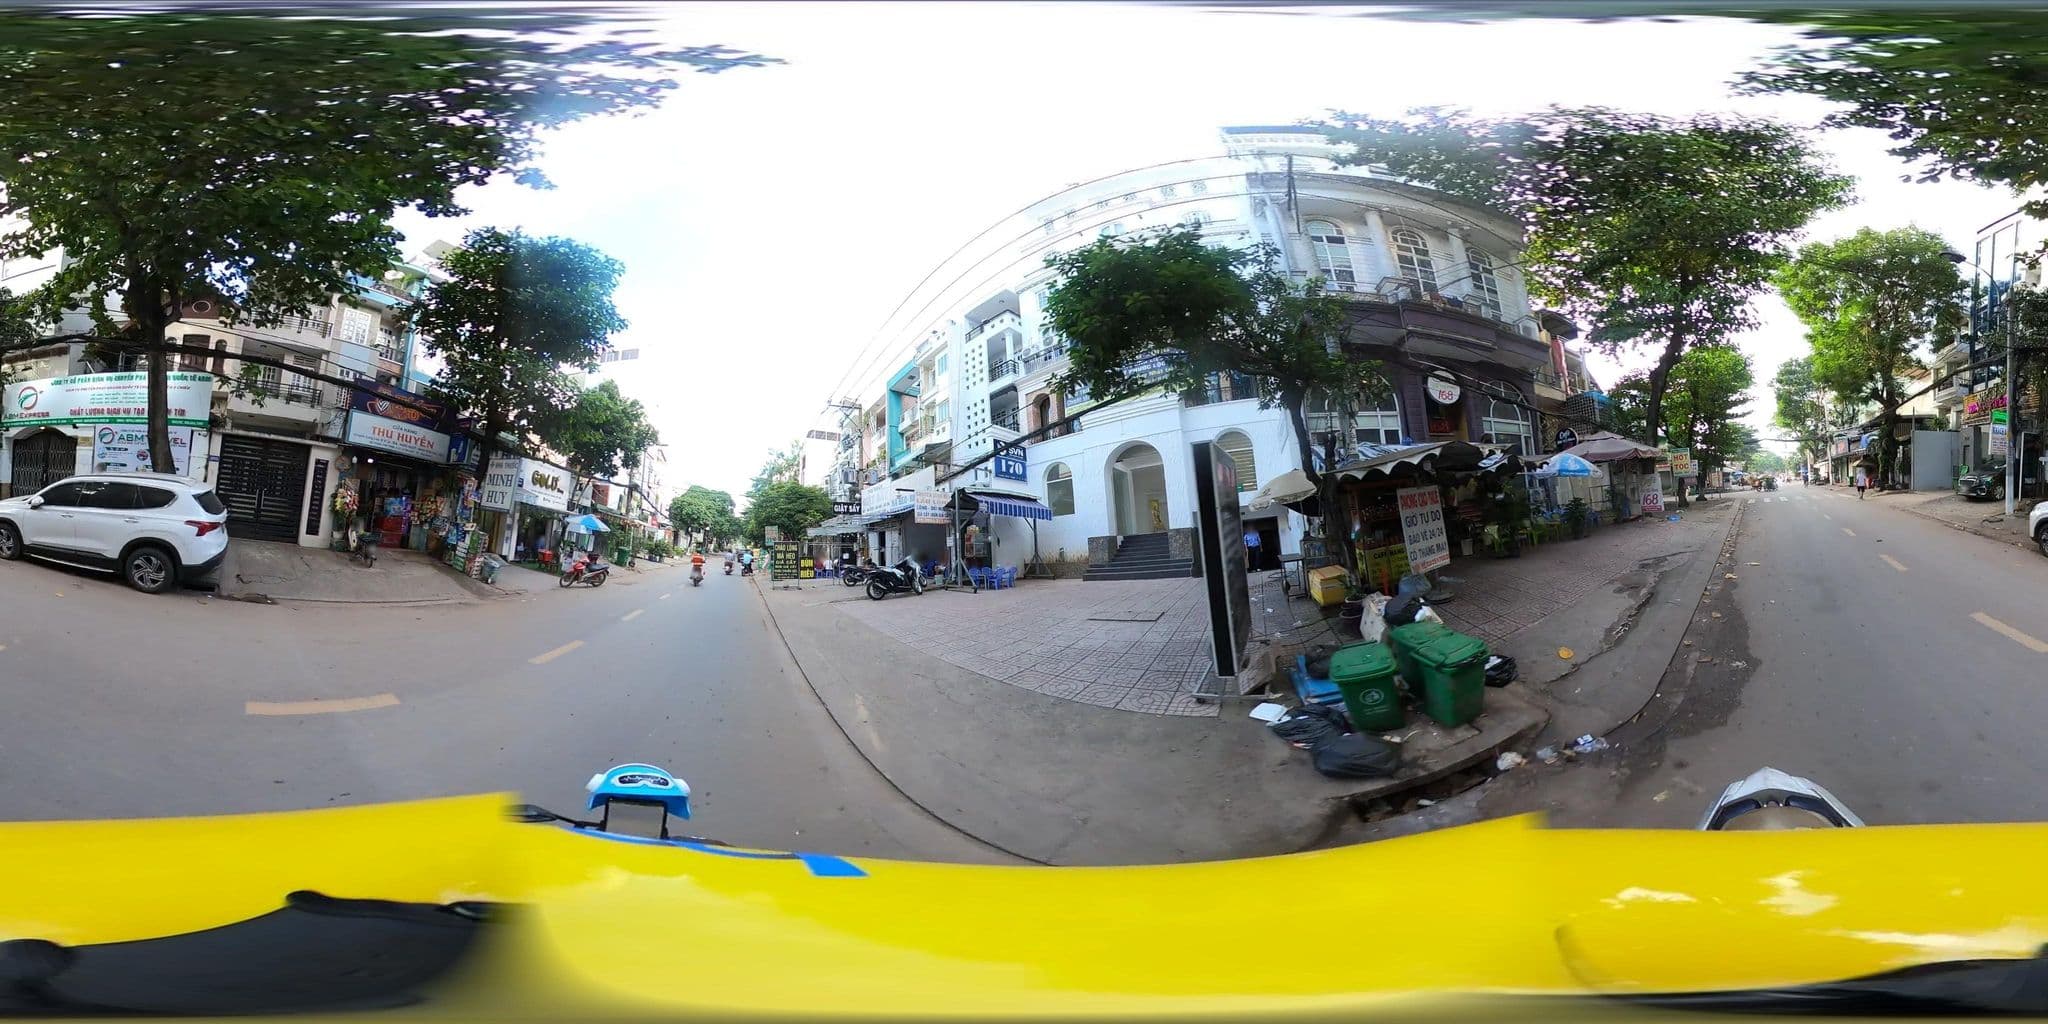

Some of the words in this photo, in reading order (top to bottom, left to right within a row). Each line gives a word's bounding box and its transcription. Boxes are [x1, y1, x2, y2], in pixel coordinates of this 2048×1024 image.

[372, 426, 394, 438] THU
[1008, 448, 1024, 457] SVN
[1002, 458, 1023, 475] 170
[487, 474, 514, 487] MINH
[486, 490, 508, 504] HUY
[1642, 494, 1659, 506] 168
[1430, 509, 1441, 522] DO
